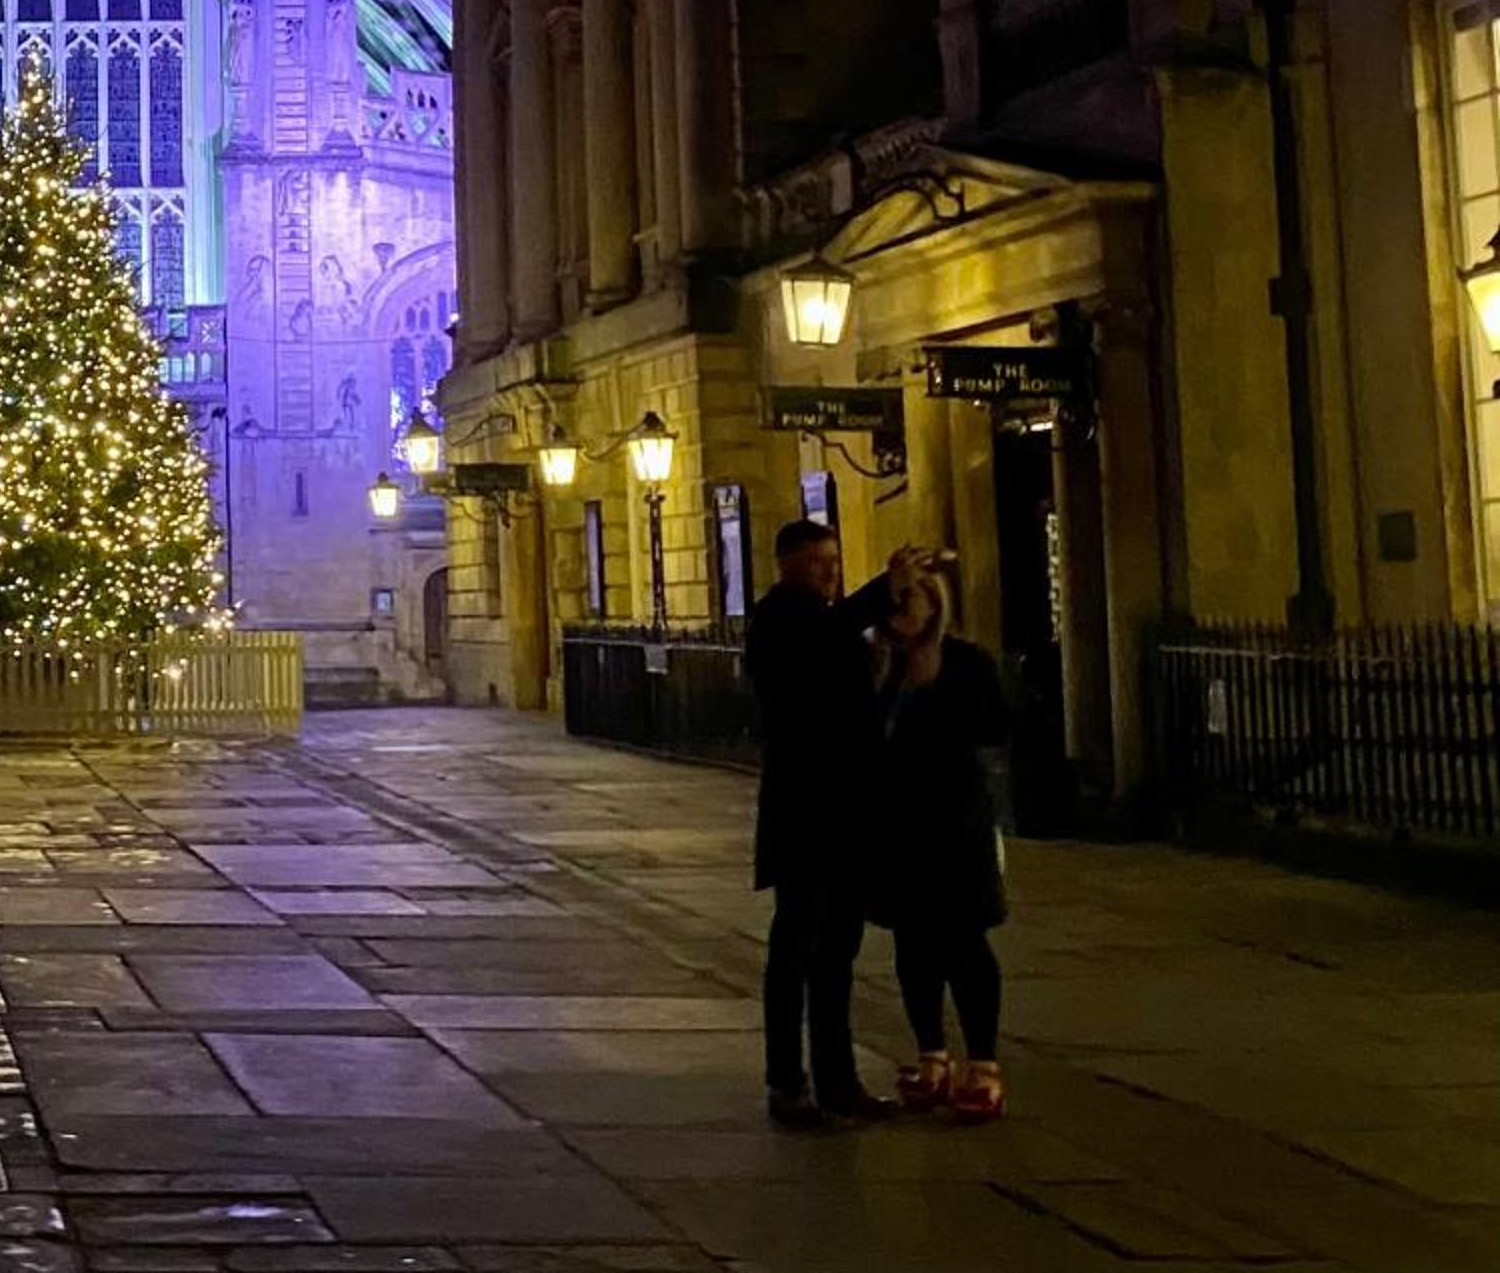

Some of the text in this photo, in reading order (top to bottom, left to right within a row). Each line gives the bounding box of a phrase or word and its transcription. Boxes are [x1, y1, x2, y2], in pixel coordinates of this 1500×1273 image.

[992, 361, 1028, 378] THE
[953, 377, 1073, 393] PUMP ROOM
[816, 400, 846, 414] THE
[782, 411, 826, 427] PUMP
